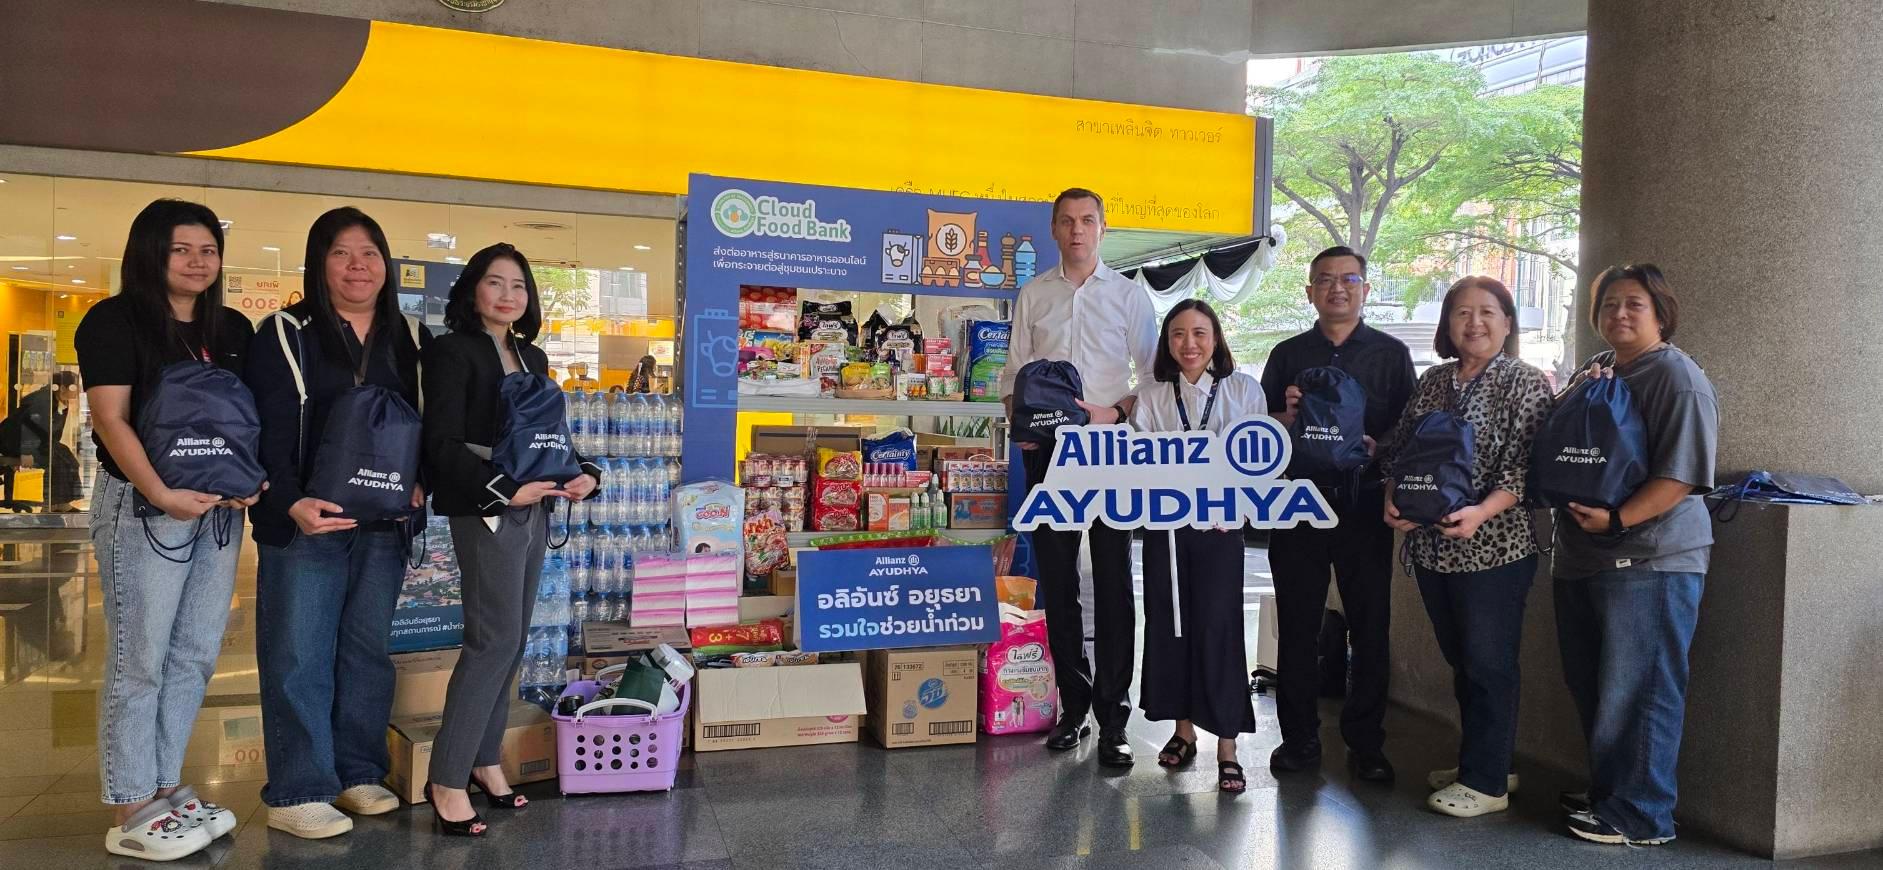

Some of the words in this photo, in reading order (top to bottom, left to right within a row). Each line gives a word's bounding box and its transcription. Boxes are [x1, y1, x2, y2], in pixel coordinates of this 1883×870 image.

[1076, 118, 1162, 138] สาขาเพลินจิต
[1169, 126, 1223, 143] ทาวเวอร์
[757, 199, 812, 219] Cloud
[756, 216, 802, 235] Food
[806, 220, 849, 239] Bank
[713, 246, 867, 265] ส่งต่ออาหารสู่ธนาคารอาหารออนไลน์
[713, 260, 848, 276] เพื่อกระจายต่อสู่ชุมชนเปราะบาง
[1029, 416, 1070, 428] AYUDHYA
[1033, 411, 1054, 421] Allianz
[1305, 425, 1329, 434] Allianz
[176, 437, 211, 447] Allianz
[1300, 433, 1344, 442] AYUDHYA
[169, 447, 234, 457] AYUDHYA
[1056, 429, 1210, 467] Allianz
[1562, 446, 1590, 457] Allianz
[1555, 454, 1608, 465] AYUDHYA
[357, 468, 388, 480] Allianz
[348, 477, 404, 492] AYUDHYA
[1398, 482, 1438, 491] AYUDHYA
[1019, 486, 1330, 524] AYUDHYA
[875, 556, 906, 565] Allianz
[869, 567, 929, 577] AYUDHYA
[817, 585, 900, 610] อลิอันซ์
[908, 586, 982, 611] อยุธยา
[818, 608, 984, 639] รวมใจช่วยน้ำท่วม
